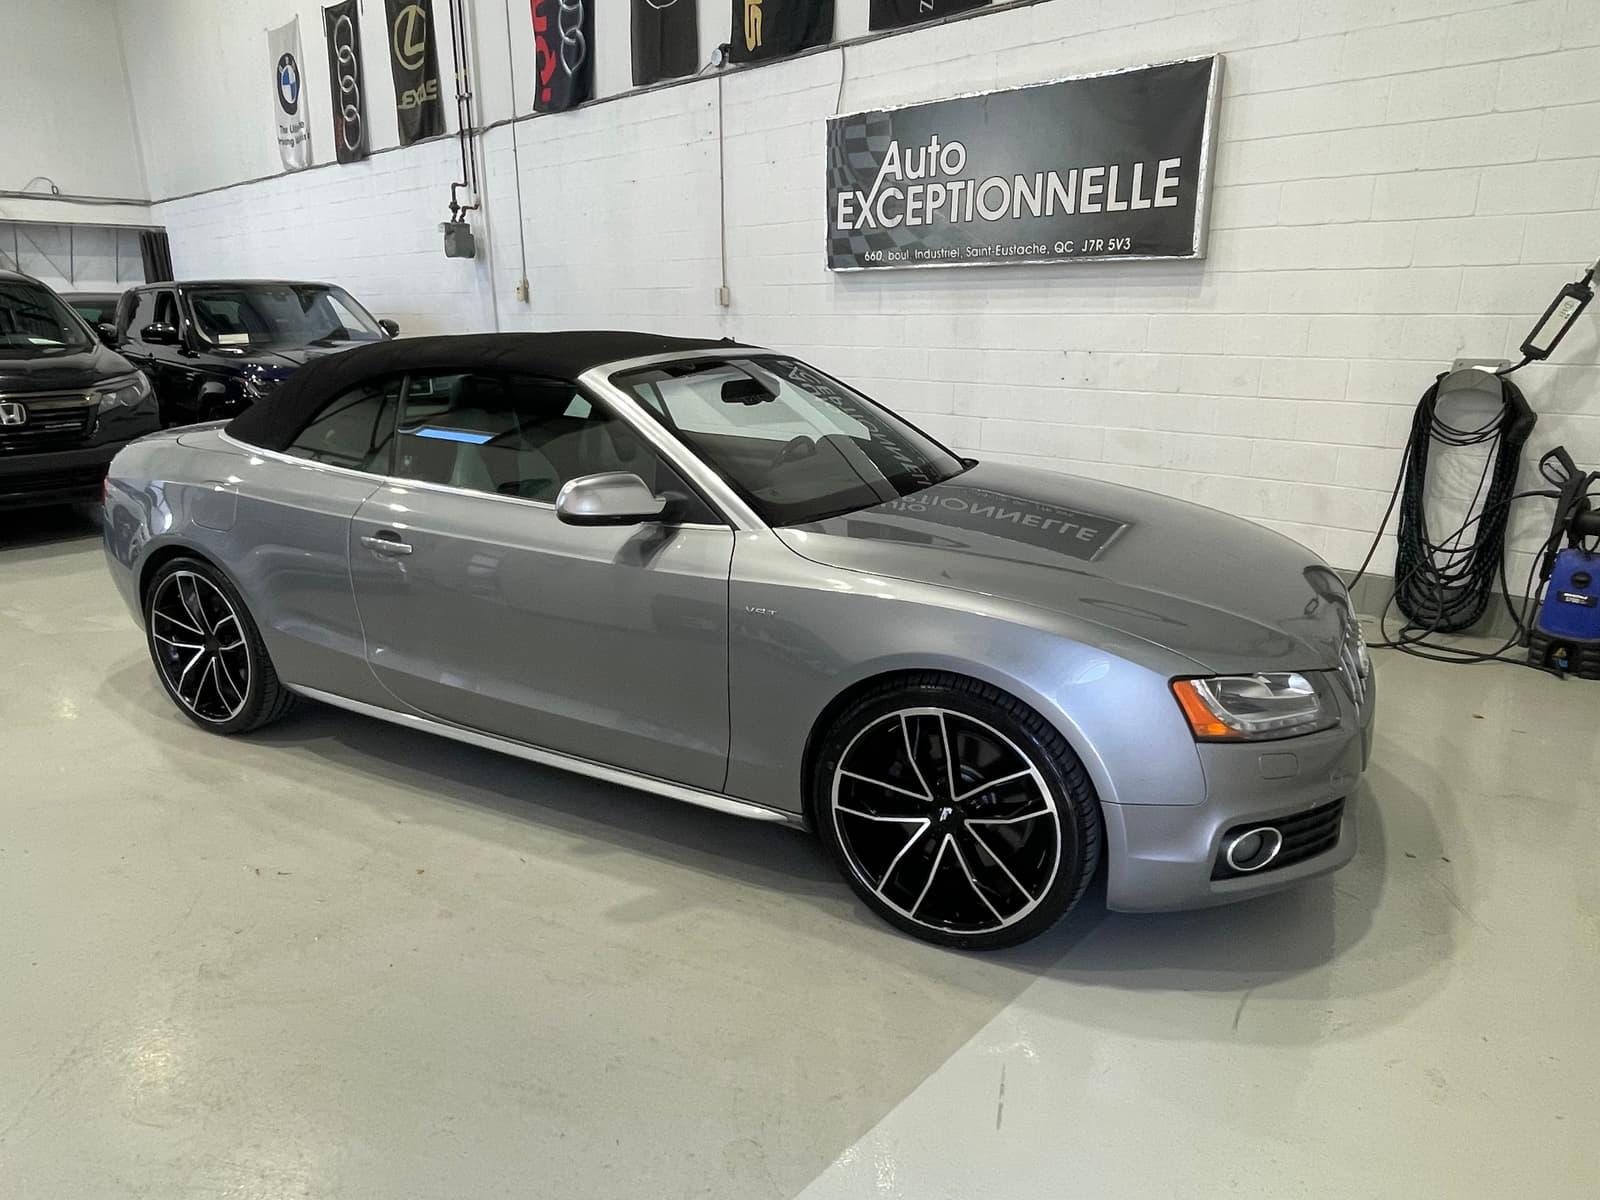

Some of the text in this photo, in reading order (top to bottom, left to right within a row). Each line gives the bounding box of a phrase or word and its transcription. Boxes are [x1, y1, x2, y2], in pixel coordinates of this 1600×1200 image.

[872, 135, 967, 185] Auto
[837, 157, 1181, 230] EXCEPTIONNELLE
[864, 237, 1131, 262] 660, boul. Industriel, Saint-Eustache, QC J7R 5V3
